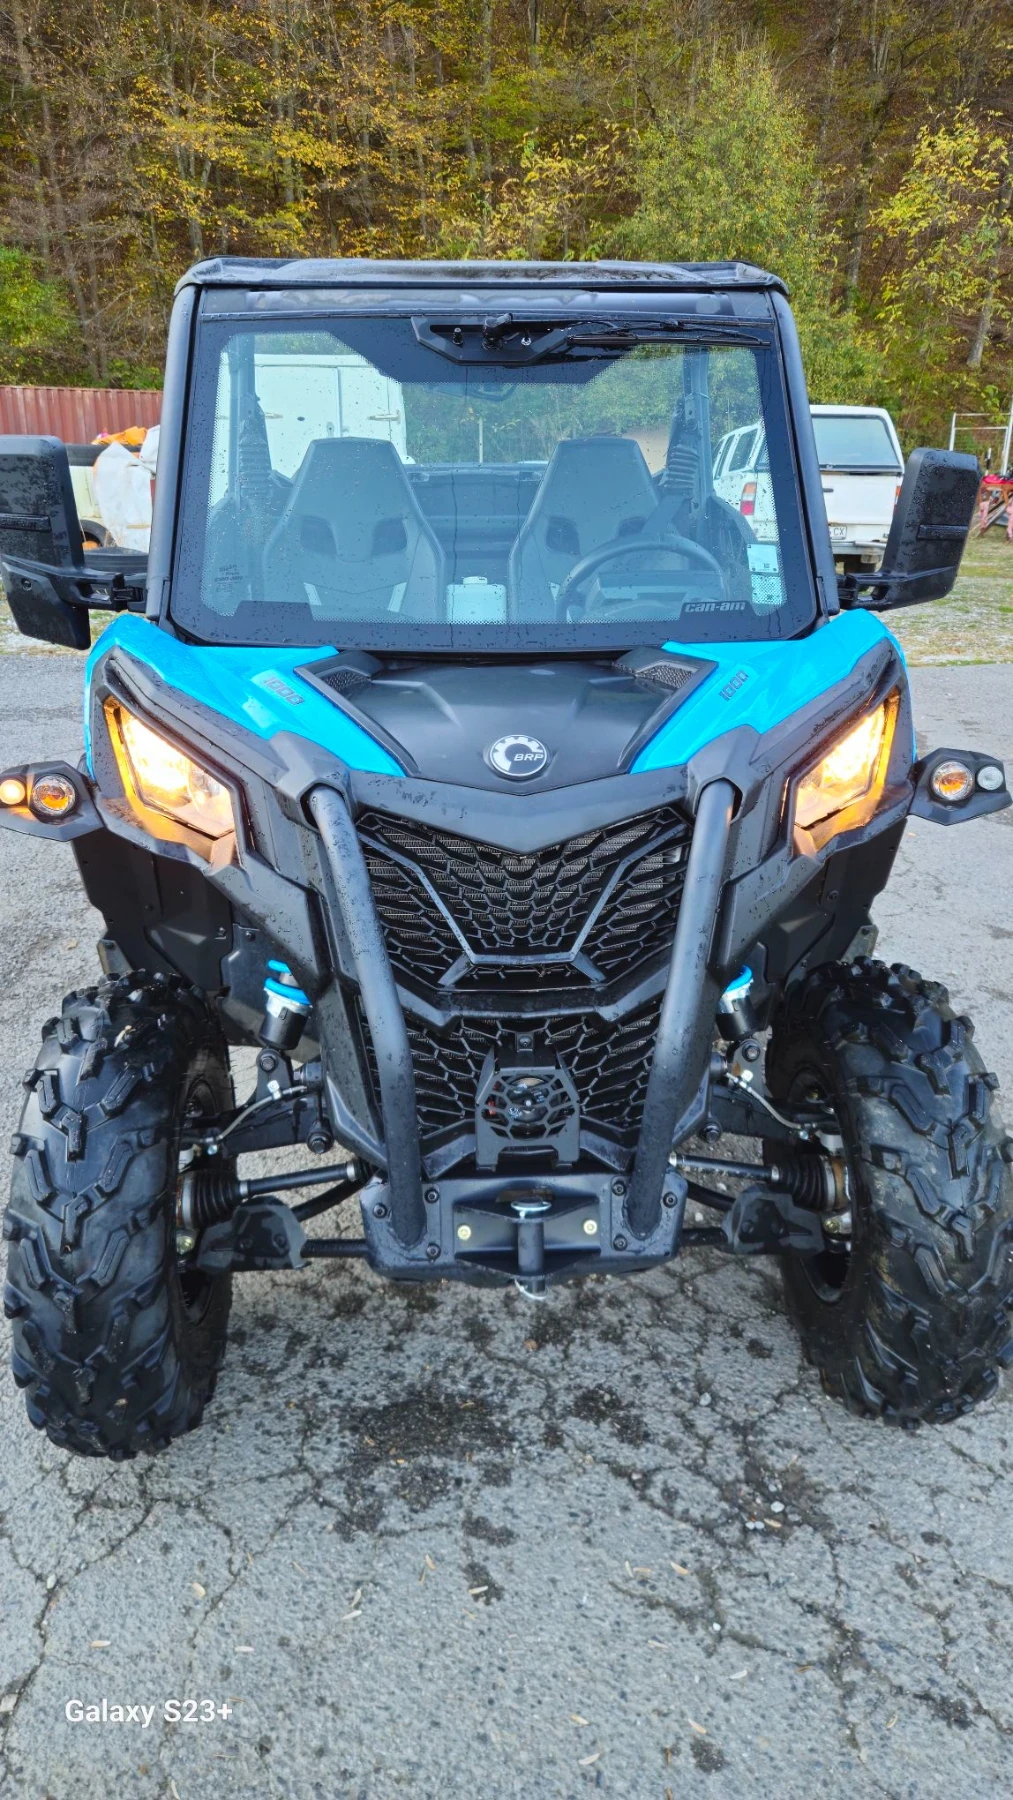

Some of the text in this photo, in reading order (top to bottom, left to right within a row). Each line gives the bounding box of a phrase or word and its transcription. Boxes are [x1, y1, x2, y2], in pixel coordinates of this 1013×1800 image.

[684, 601, 746, 613] can-am
[263, 676, 305, 706] 1000
[718, 669, 749, 702] 1000
[513, 753, 544, 762] BRP
